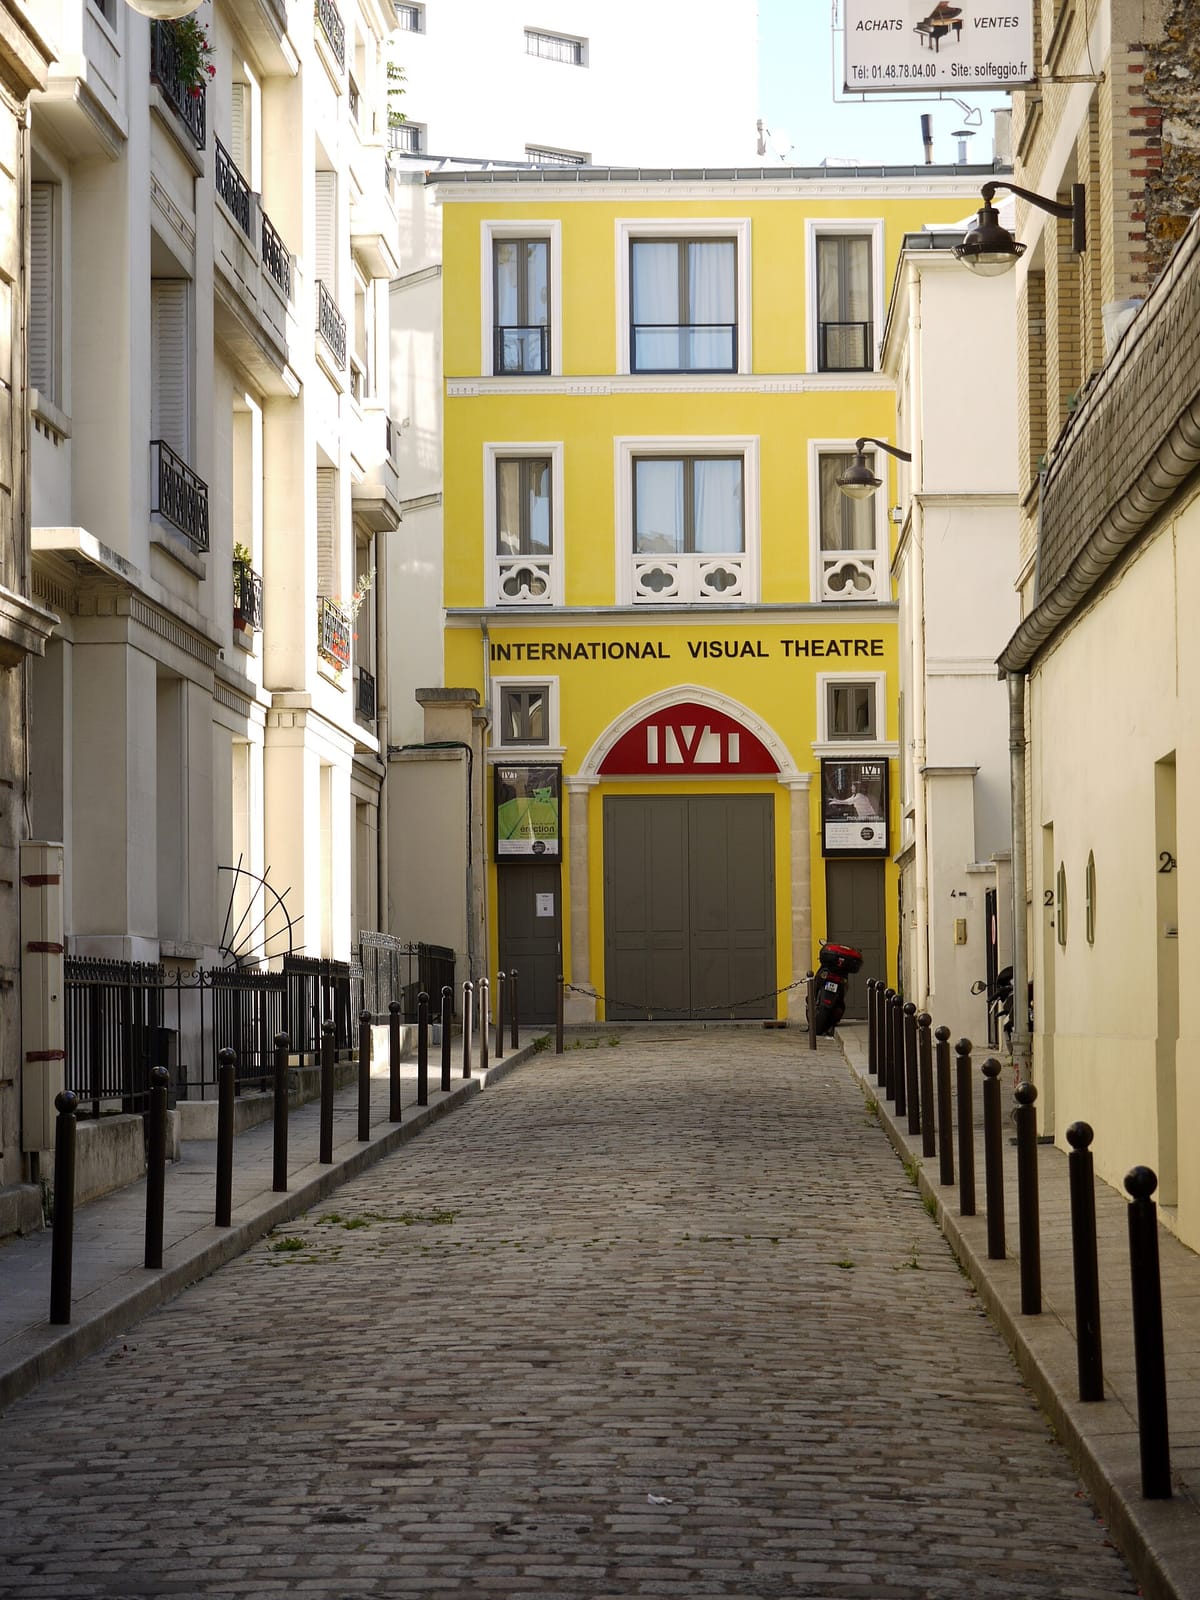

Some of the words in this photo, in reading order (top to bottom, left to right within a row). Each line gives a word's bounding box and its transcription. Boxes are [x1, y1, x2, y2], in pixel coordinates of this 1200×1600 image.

[856, 20, 903, 31] ACHATS
[973, 16, 1019, 28] VENTES
[852, 65, 869, 79] Tél:
[872, 64, 936, 78] 01.48.78.04.00
[951, 63, 972, 77] Site:
[974, 62, 1027, 79] solfeggio.fr
[491, 642, 670, 661] INTERNATIONAL
[687, 641, 769, 658] VISUAL
[780, 639, 884, 656] THEATRE
[1043, 889, 1054, 906] 2
